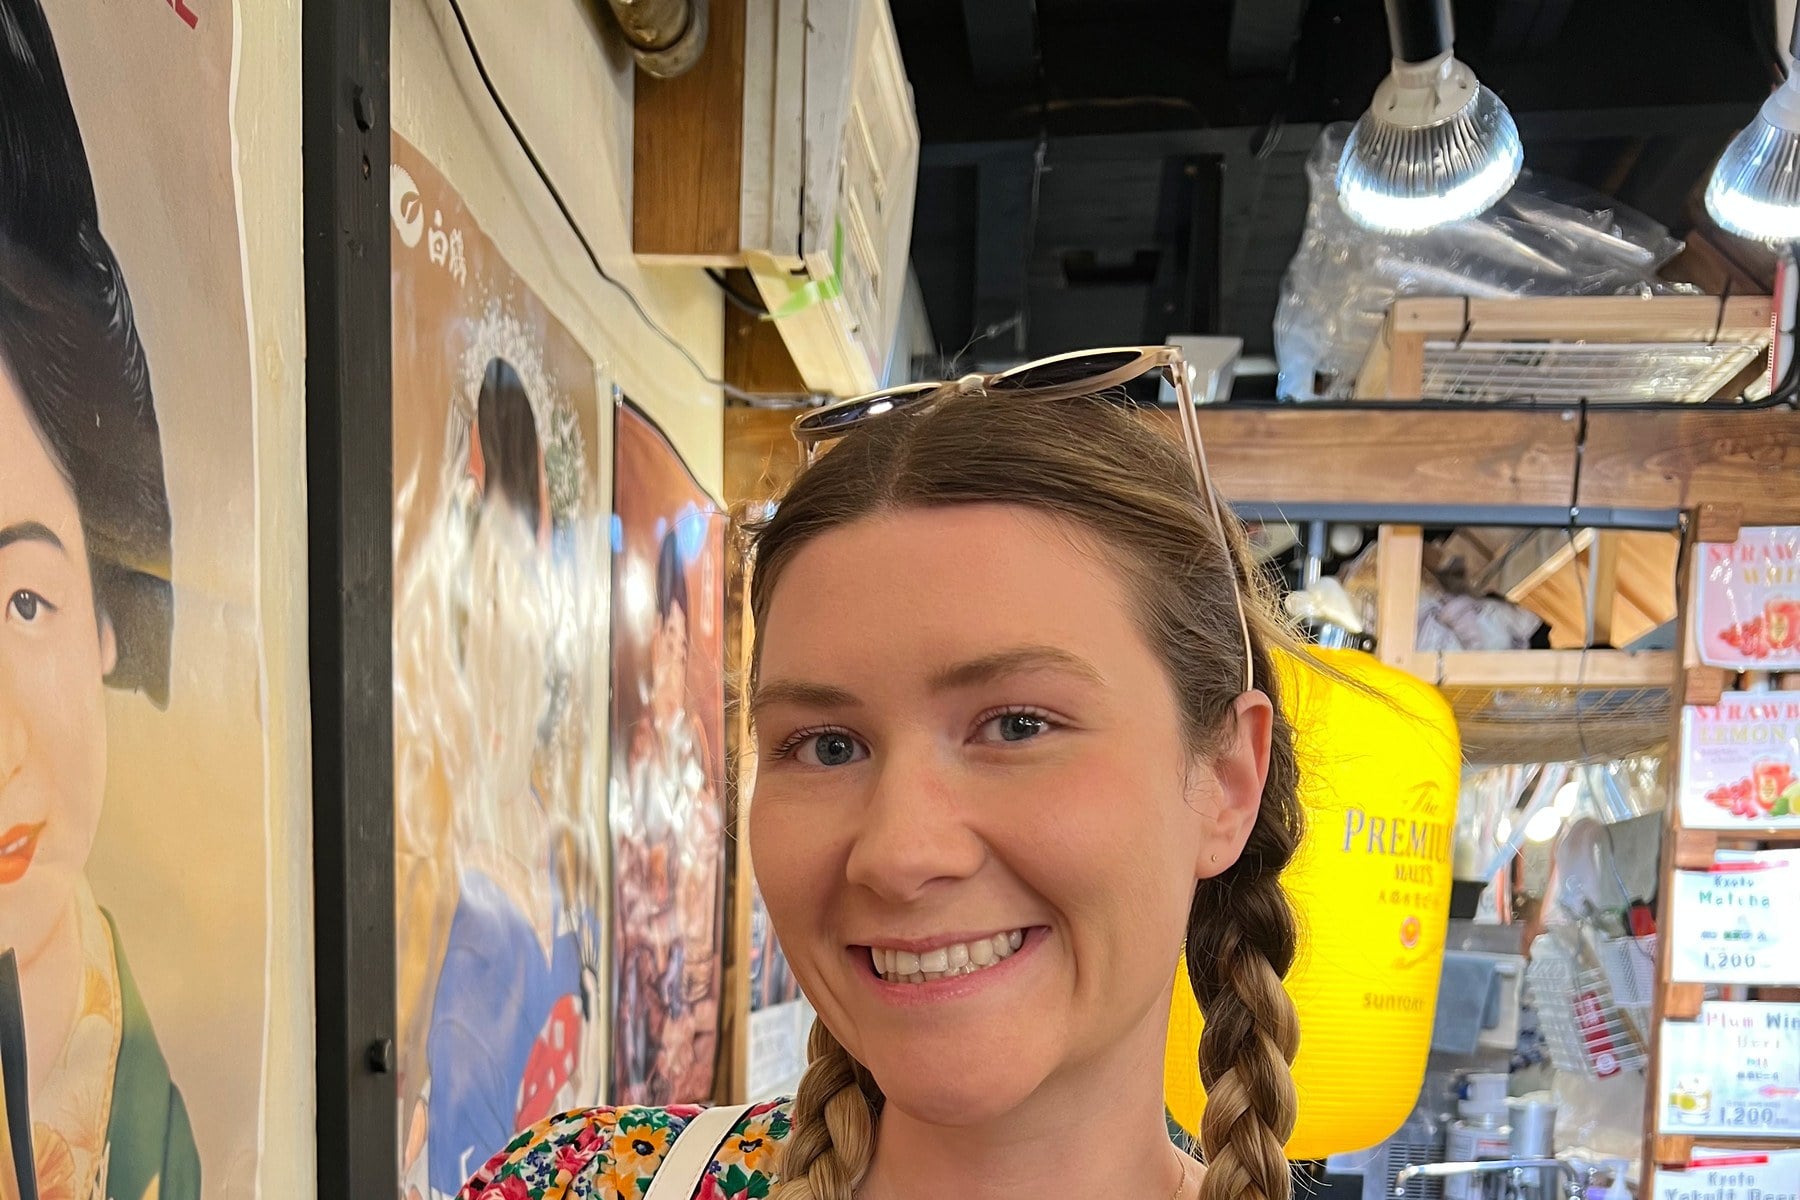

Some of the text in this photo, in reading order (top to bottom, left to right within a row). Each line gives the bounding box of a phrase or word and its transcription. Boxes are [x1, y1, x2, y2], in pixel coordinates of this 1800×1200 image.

[1699, 724, 1787, 745] LEMON
[1342, 807, 1454, 864] PREMIU
[1699, 890, 1770, 907] Matcha
[1704, 952, 1755, 969] 1,200
[1707, 1011, 1754, 1028] Plum
[1720, 1107, 1773, 1126] 1,200
[1708, 1171, 1755, 1187] Kyoto
